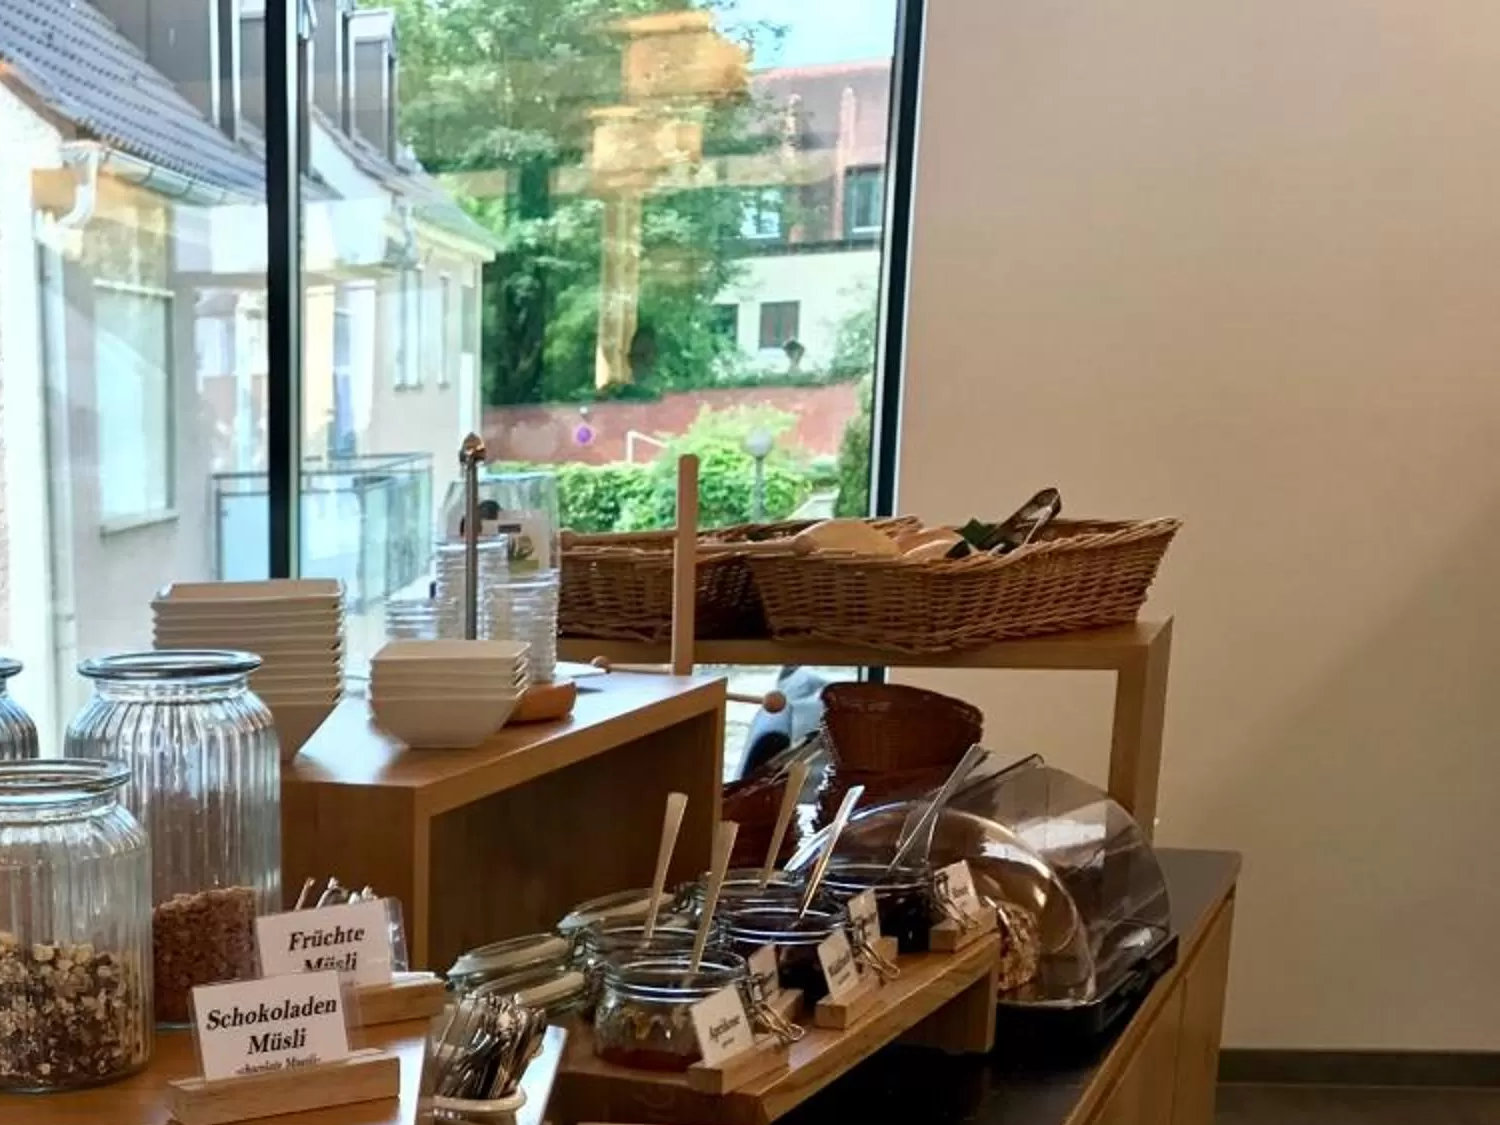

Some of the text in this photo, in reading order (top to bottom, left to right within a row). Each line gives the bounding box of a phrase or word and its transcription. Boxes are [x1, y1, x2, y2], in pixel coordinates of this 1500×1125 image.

[288, 925, 365, 951] Früchte
[205, 995, 338, 1031] Schokoladen
[247, 1027, 307, 1055] Müsli
